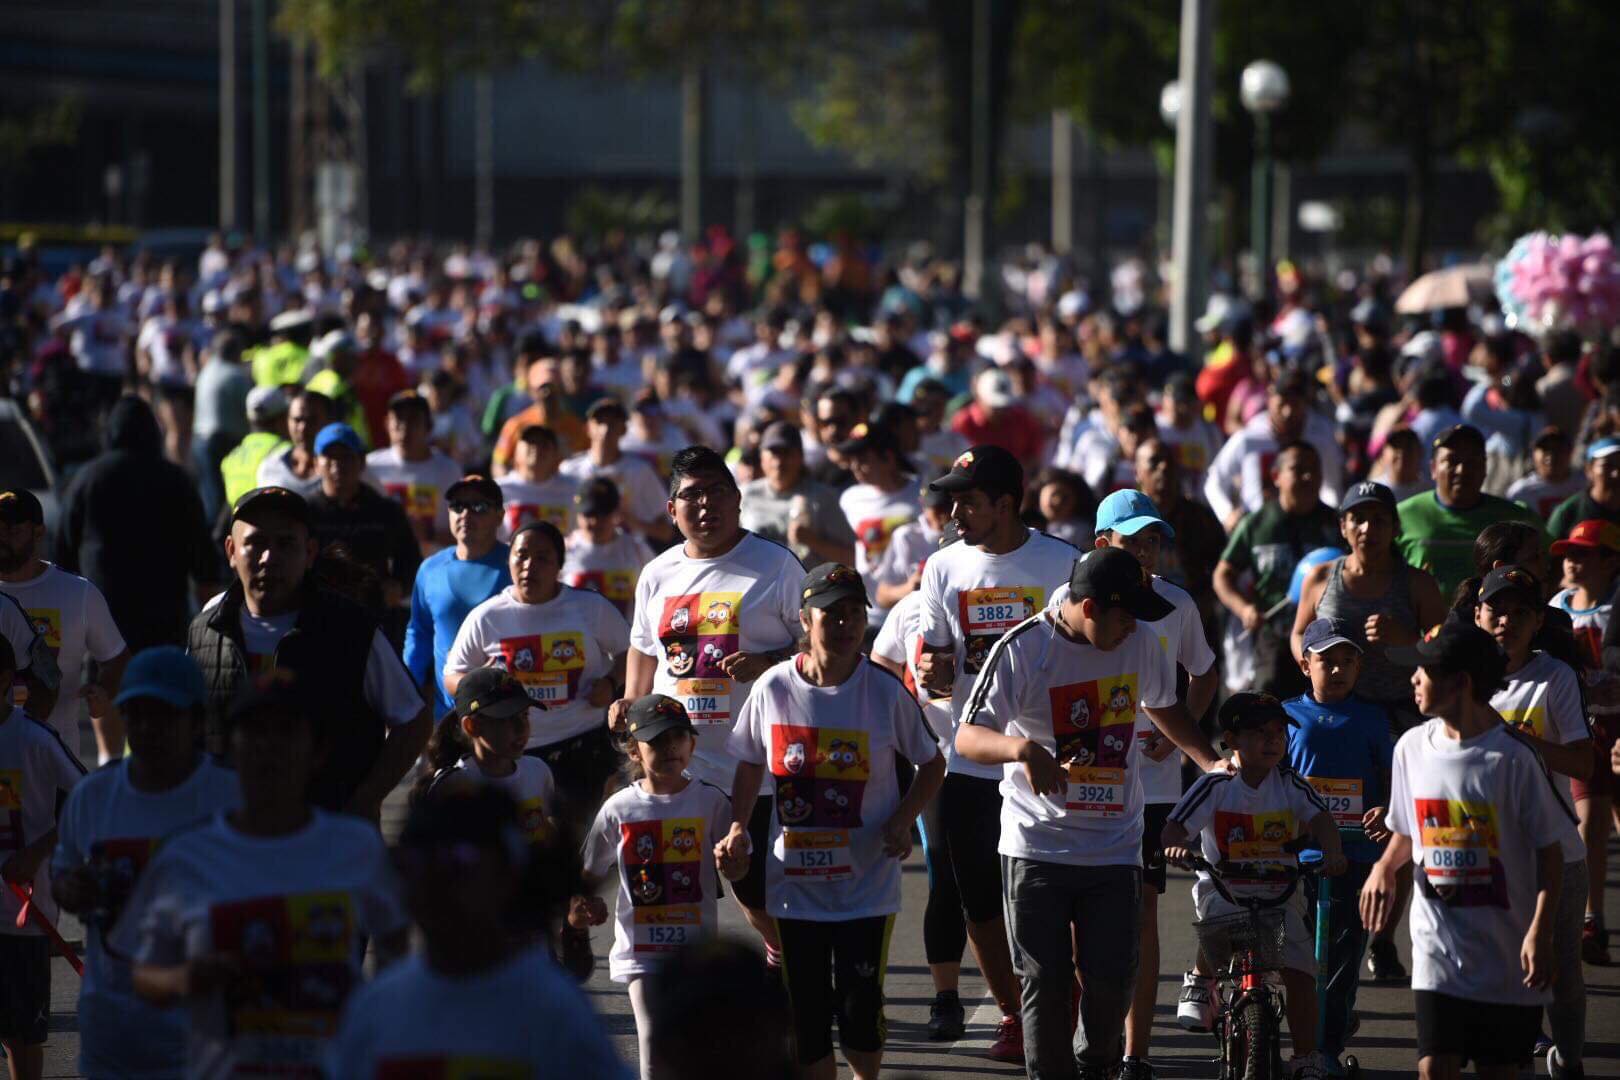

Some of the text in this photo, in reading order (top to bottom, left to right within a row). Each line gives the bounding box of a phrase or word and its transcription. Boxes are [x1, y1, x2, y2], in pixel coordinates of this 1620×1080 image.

[977, 605, 1013, 621] 3882
[687, 697, 716, 711] 0174
[1078, 785, 1114, 802] 3924
[1324, 796, 1350, 812] 129
[800, 850, 833, 867] 1521
[1432, 849, 1477, 867] 0880
[648, 926, 687, 943] 1523
